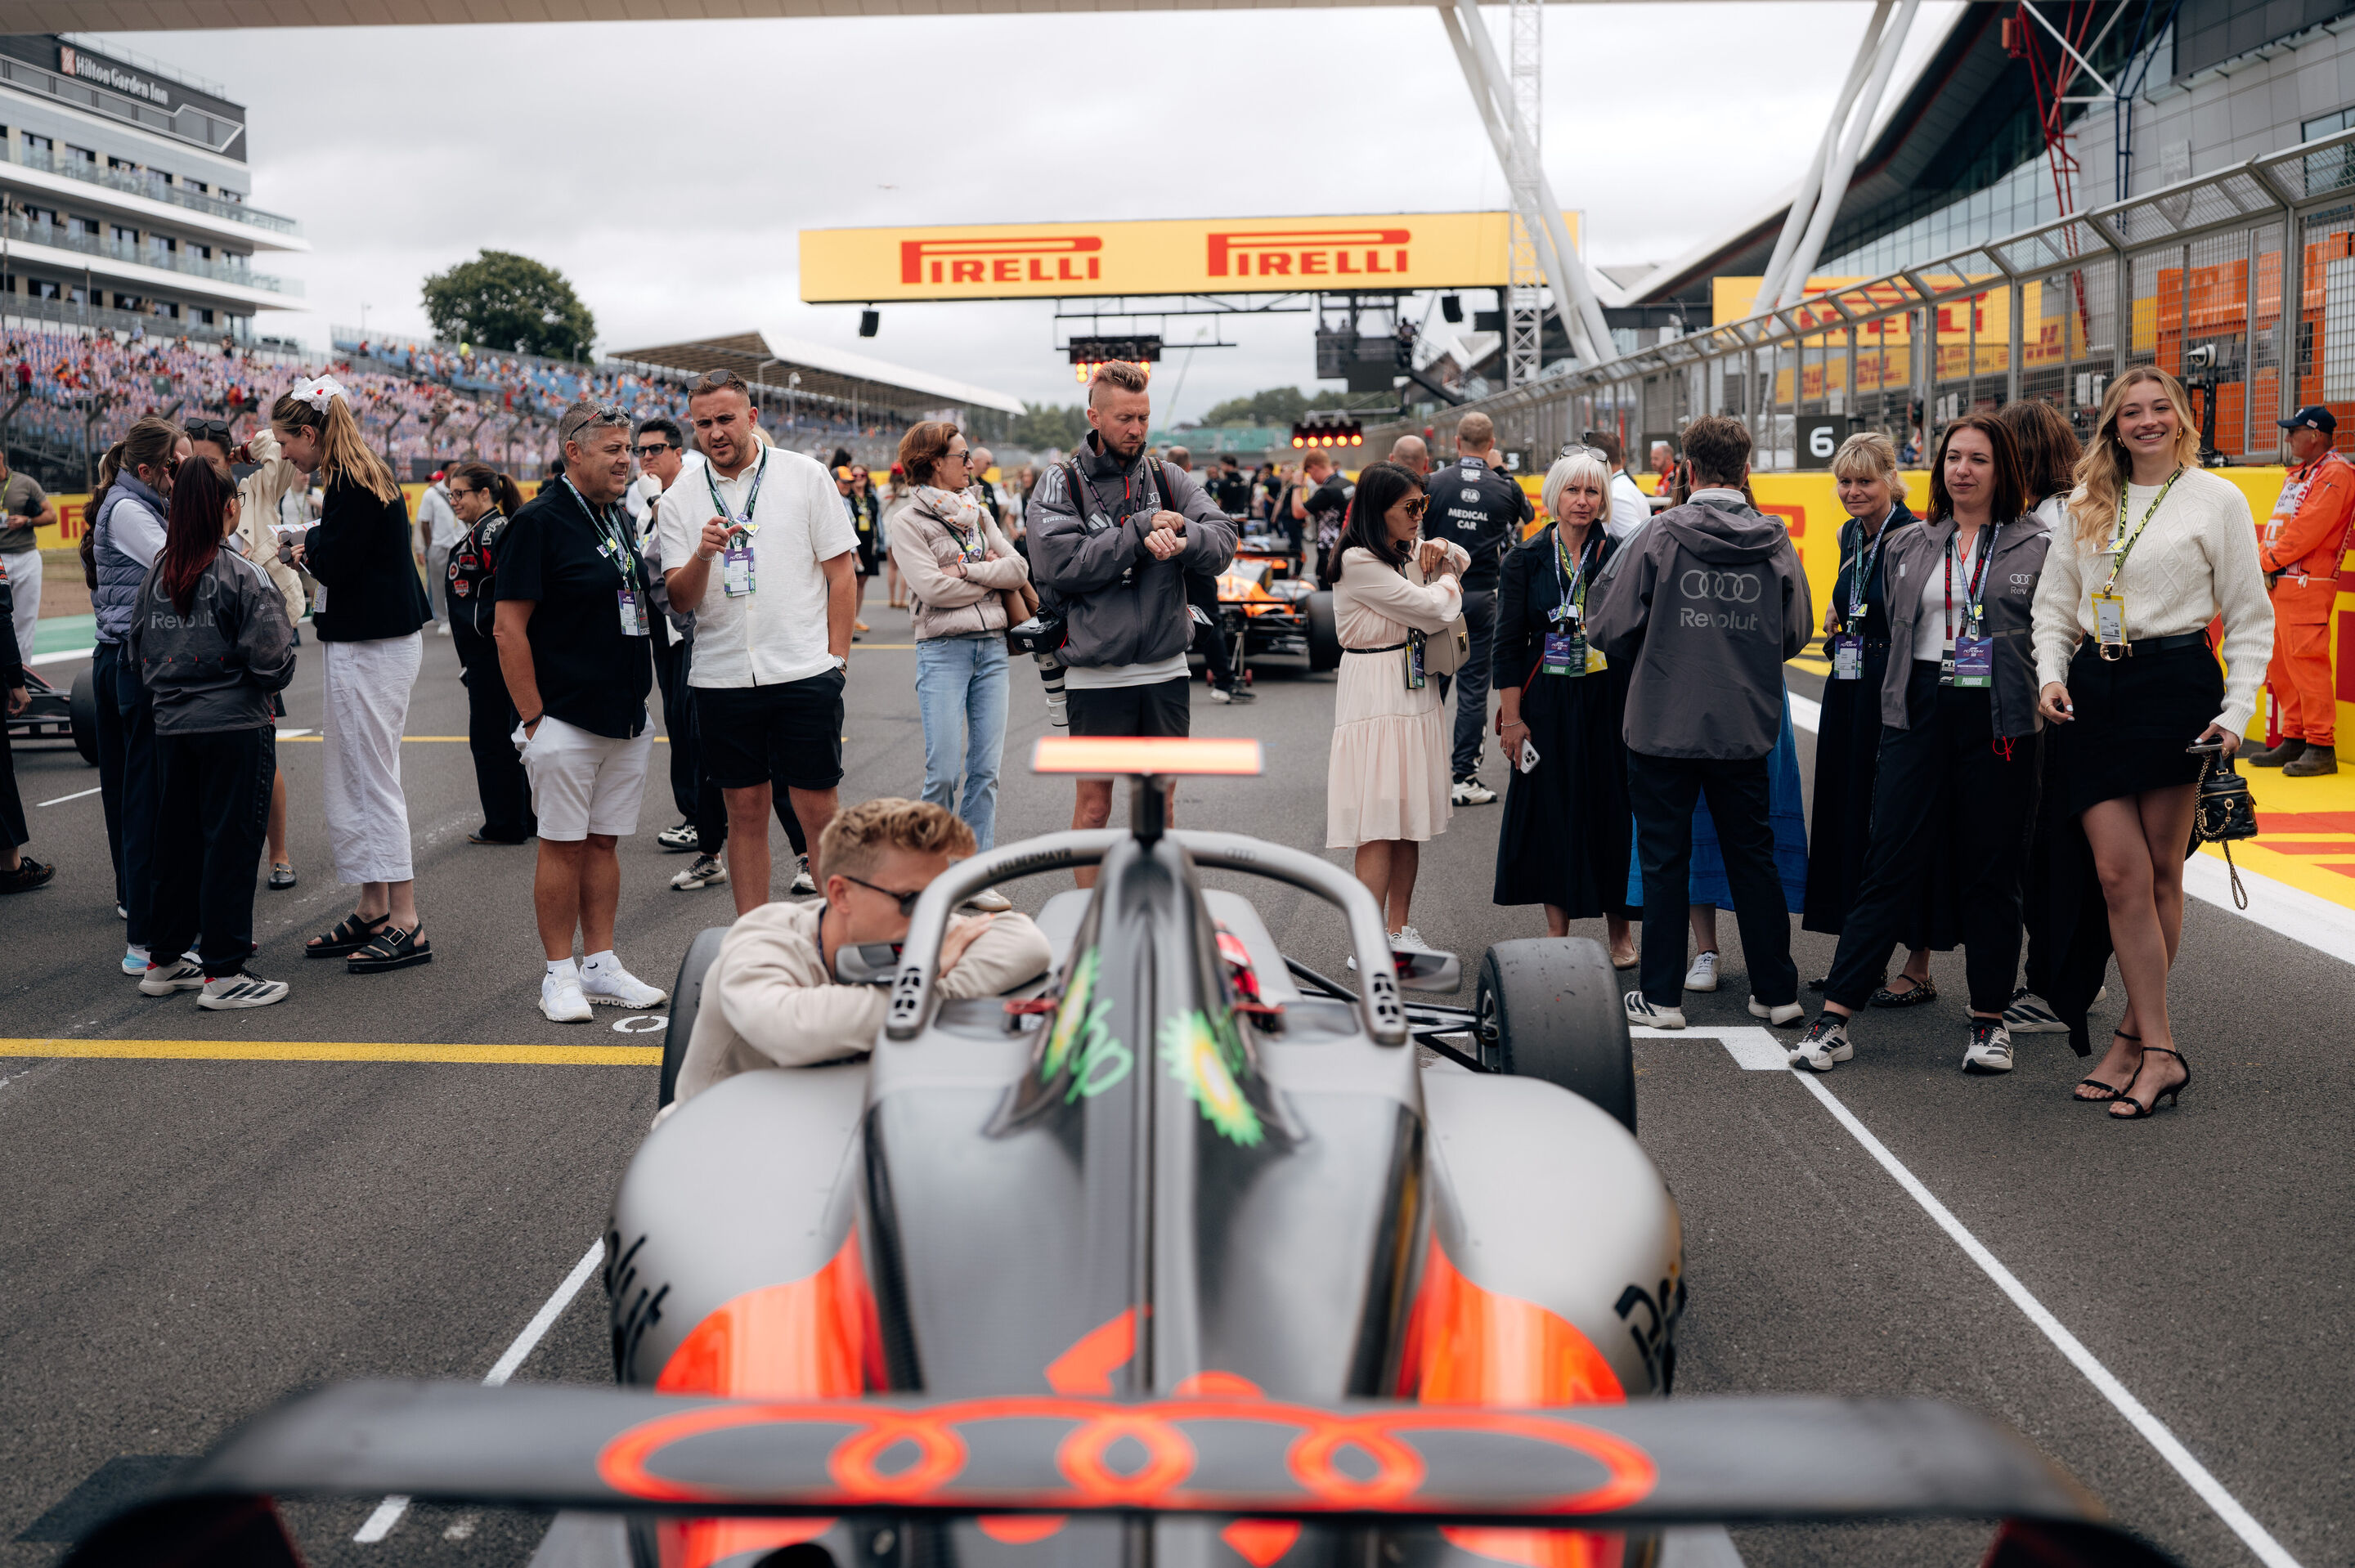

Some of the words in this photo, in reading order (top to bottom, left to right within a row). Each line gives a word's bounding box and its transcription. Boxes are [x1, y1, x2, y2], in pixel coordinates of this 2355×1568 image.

[76, 55, 110, 84] Hilton
[111, 68, 149, 99] Garden
[150, 82, 168, 105] Inn
[900, 236, 1102, 284] PIRELLI
[1208, 229, 1411, 276] PIRELLI
[1810, 427, 1834, 458] 6
[1506, 453, 1519, 470] 3
[1447, 508, 1488, 522] MEDICAL
[1457, 520, 1476, 531] CAR
[1680, 607, 1758, 631] Revolut
